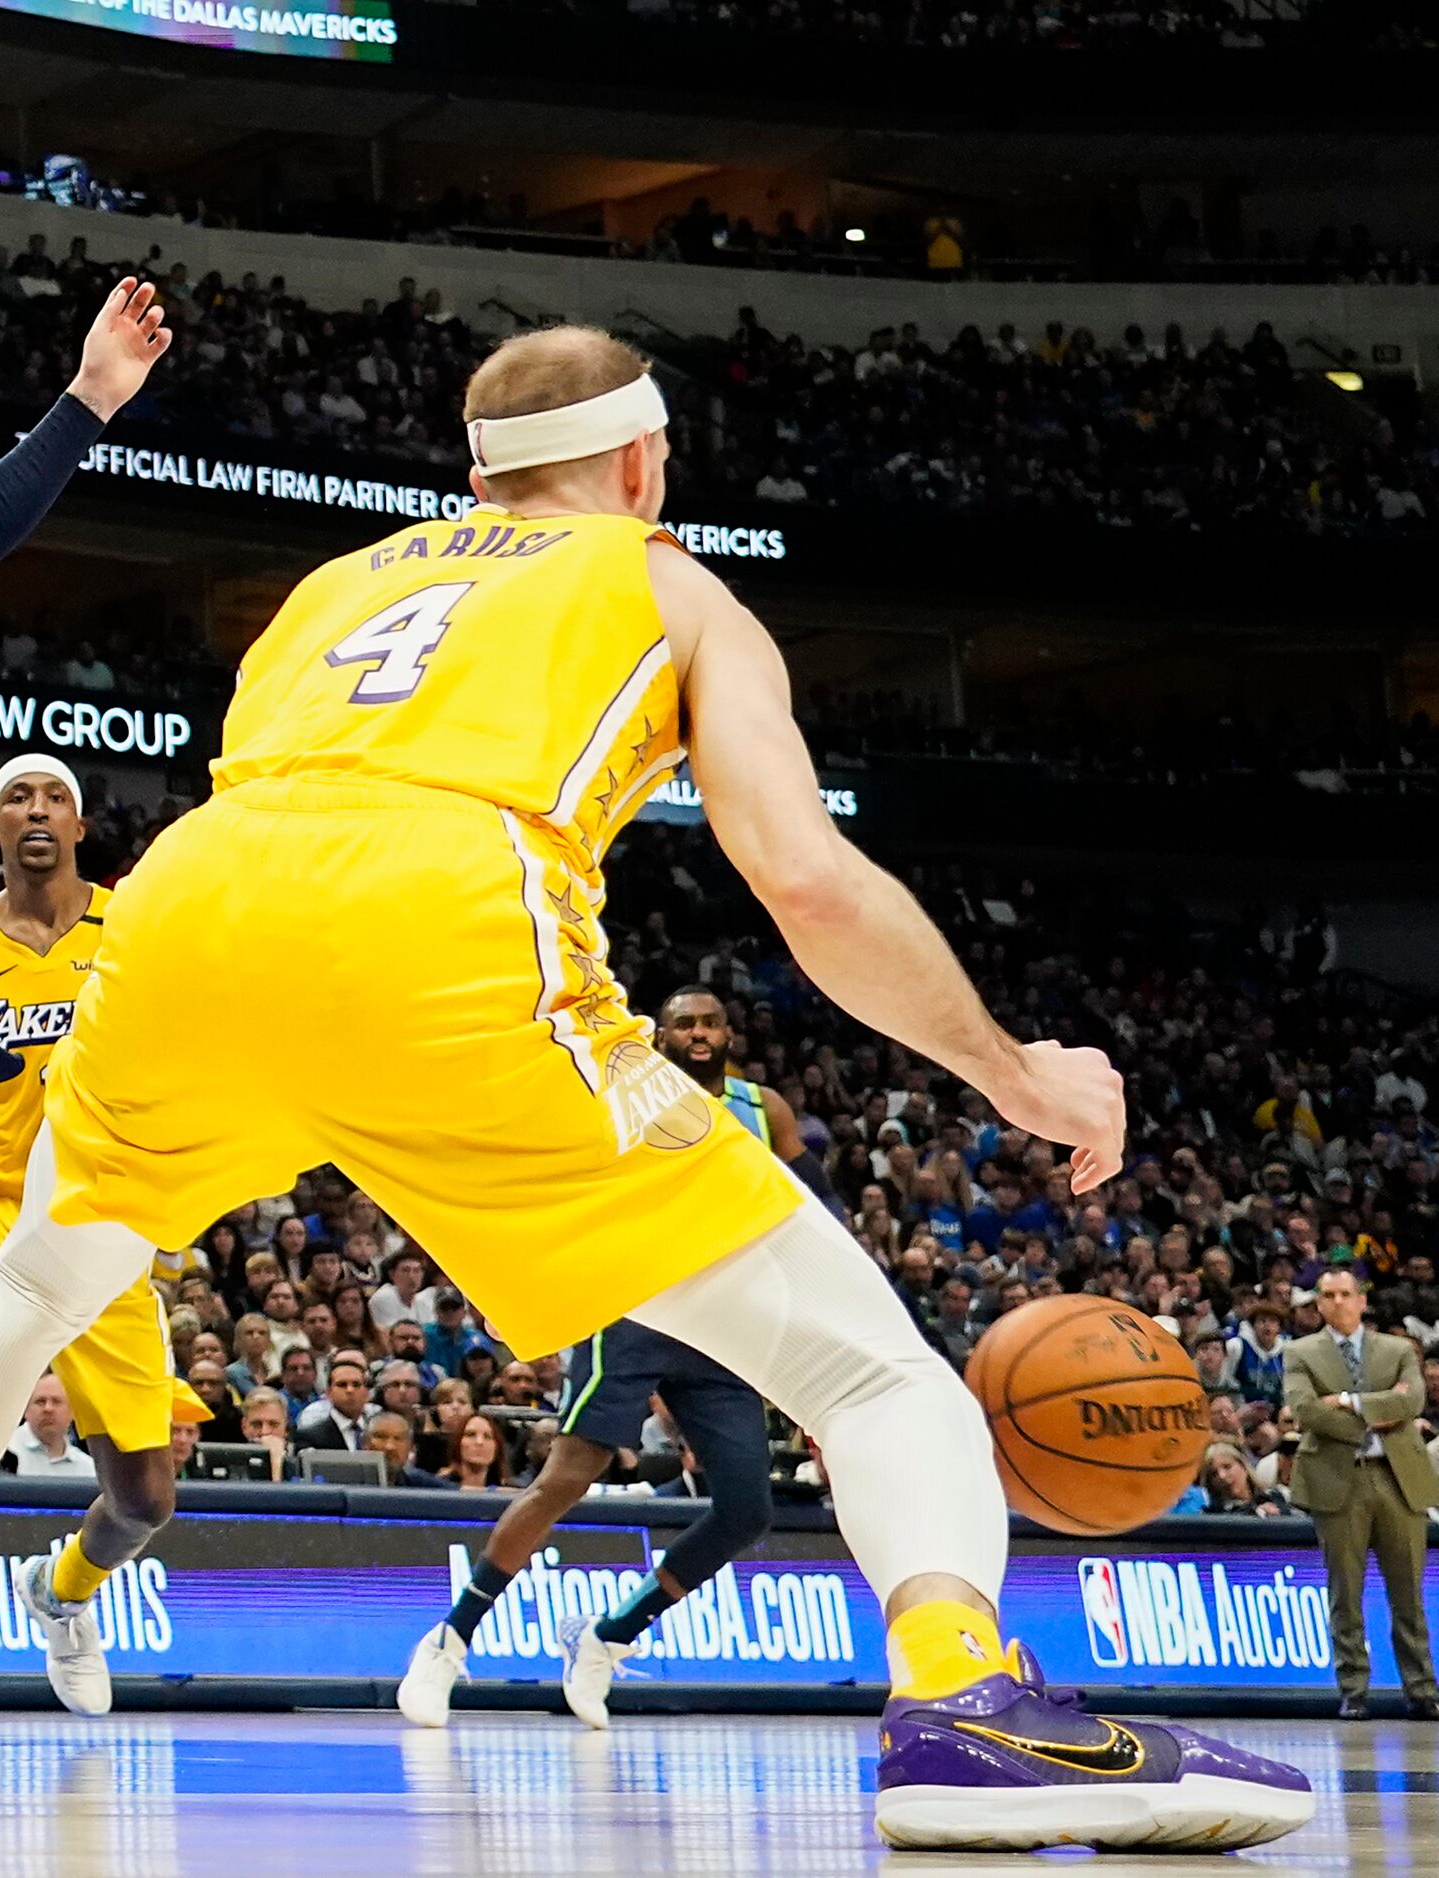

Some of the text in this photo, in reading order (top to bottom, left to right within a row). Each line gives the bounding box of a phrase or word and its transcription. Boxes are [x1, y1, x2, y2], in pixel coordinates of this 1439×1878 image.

[173, 0, 259, 32] DALLAS
[260, 9, 398, 45] MAVERICKS
[196, 457, 254, 492] LAW
[256, 466, 322, 504] FIRM
[324, 475, 439, 520] PARTNER
[370, 525, 574, 572] CARUSO
[324, 580, 479, 705] 4
[41, 700, 192, 758] GROUP
[1116, 1560, 1332, 1669] NBA Auctio
